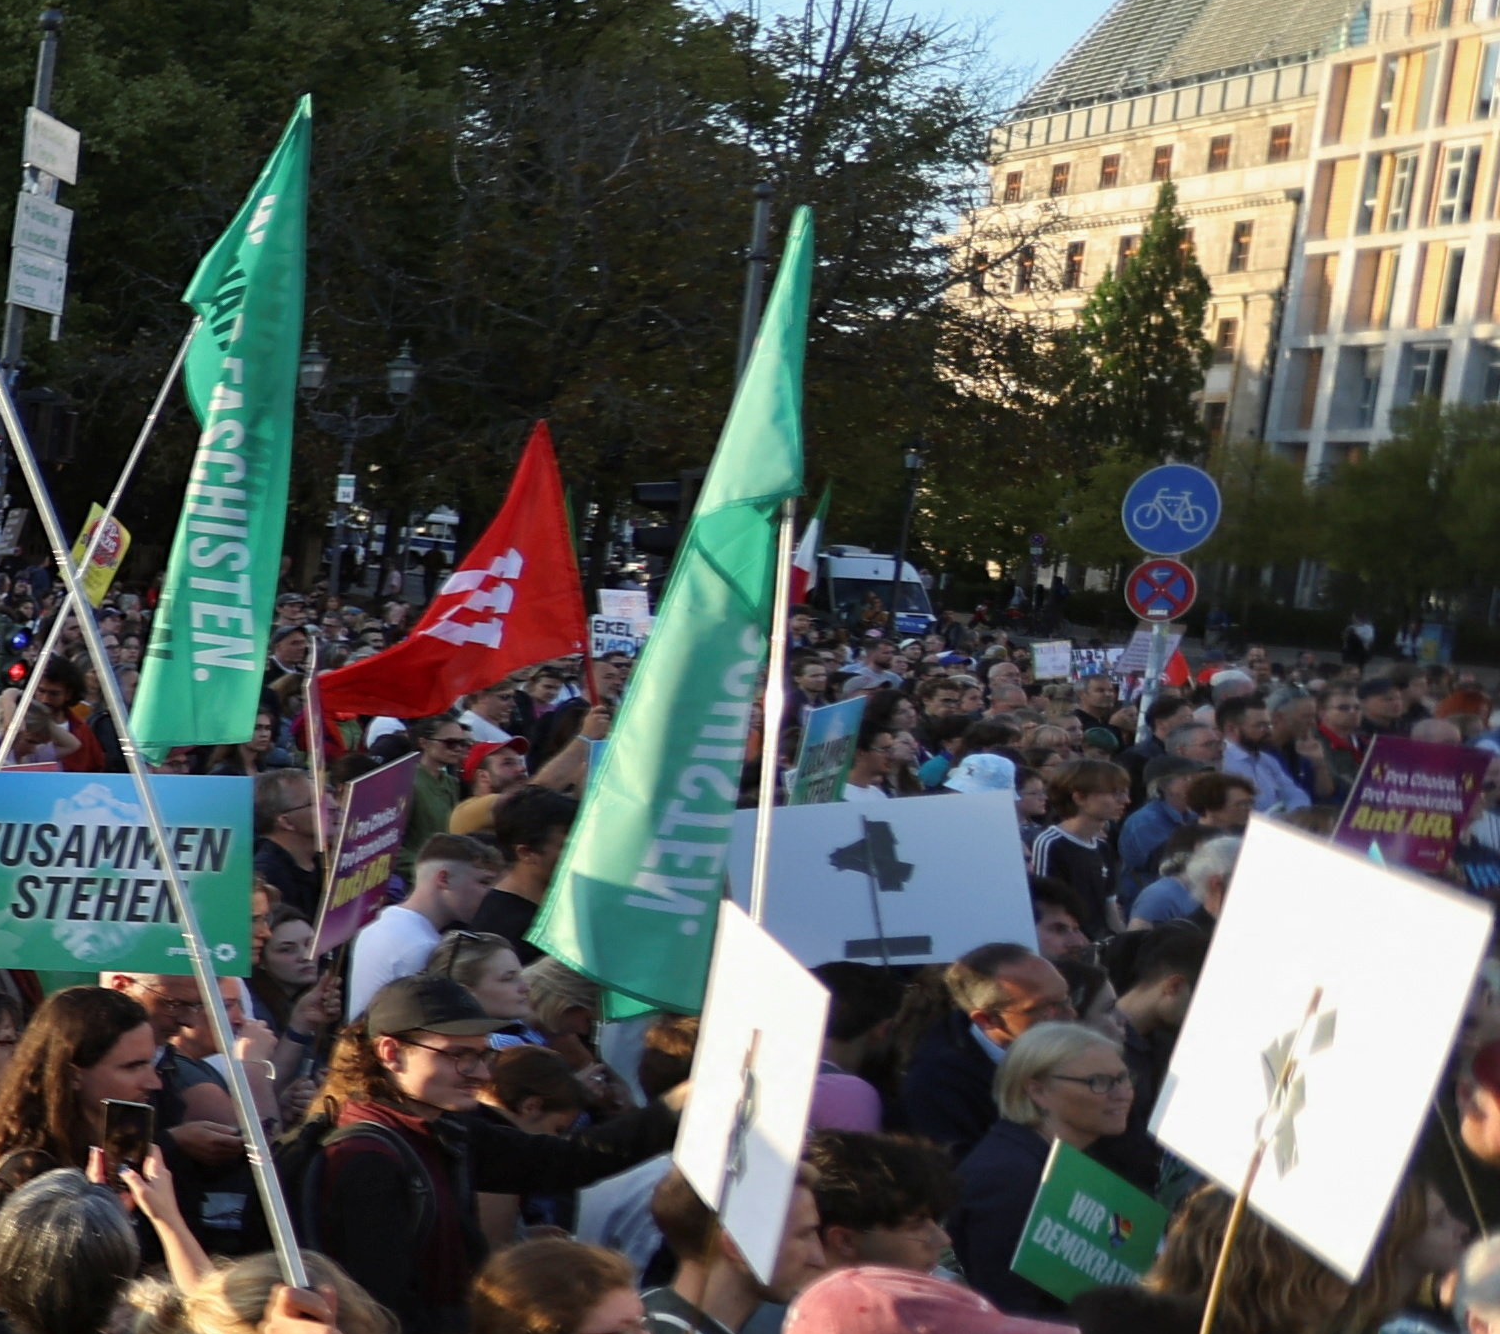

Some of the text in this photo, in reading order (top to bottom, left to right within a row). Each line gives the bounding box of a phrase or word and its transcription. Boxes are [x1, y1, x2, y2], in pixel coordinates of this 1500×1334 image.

[594, 619, 634, 637] EKEL
[1350, 805, 1407, 834] Anti
[11, 874, 190, 924] STEHEN
[1066, 1189, 1108, 1235] WIR
